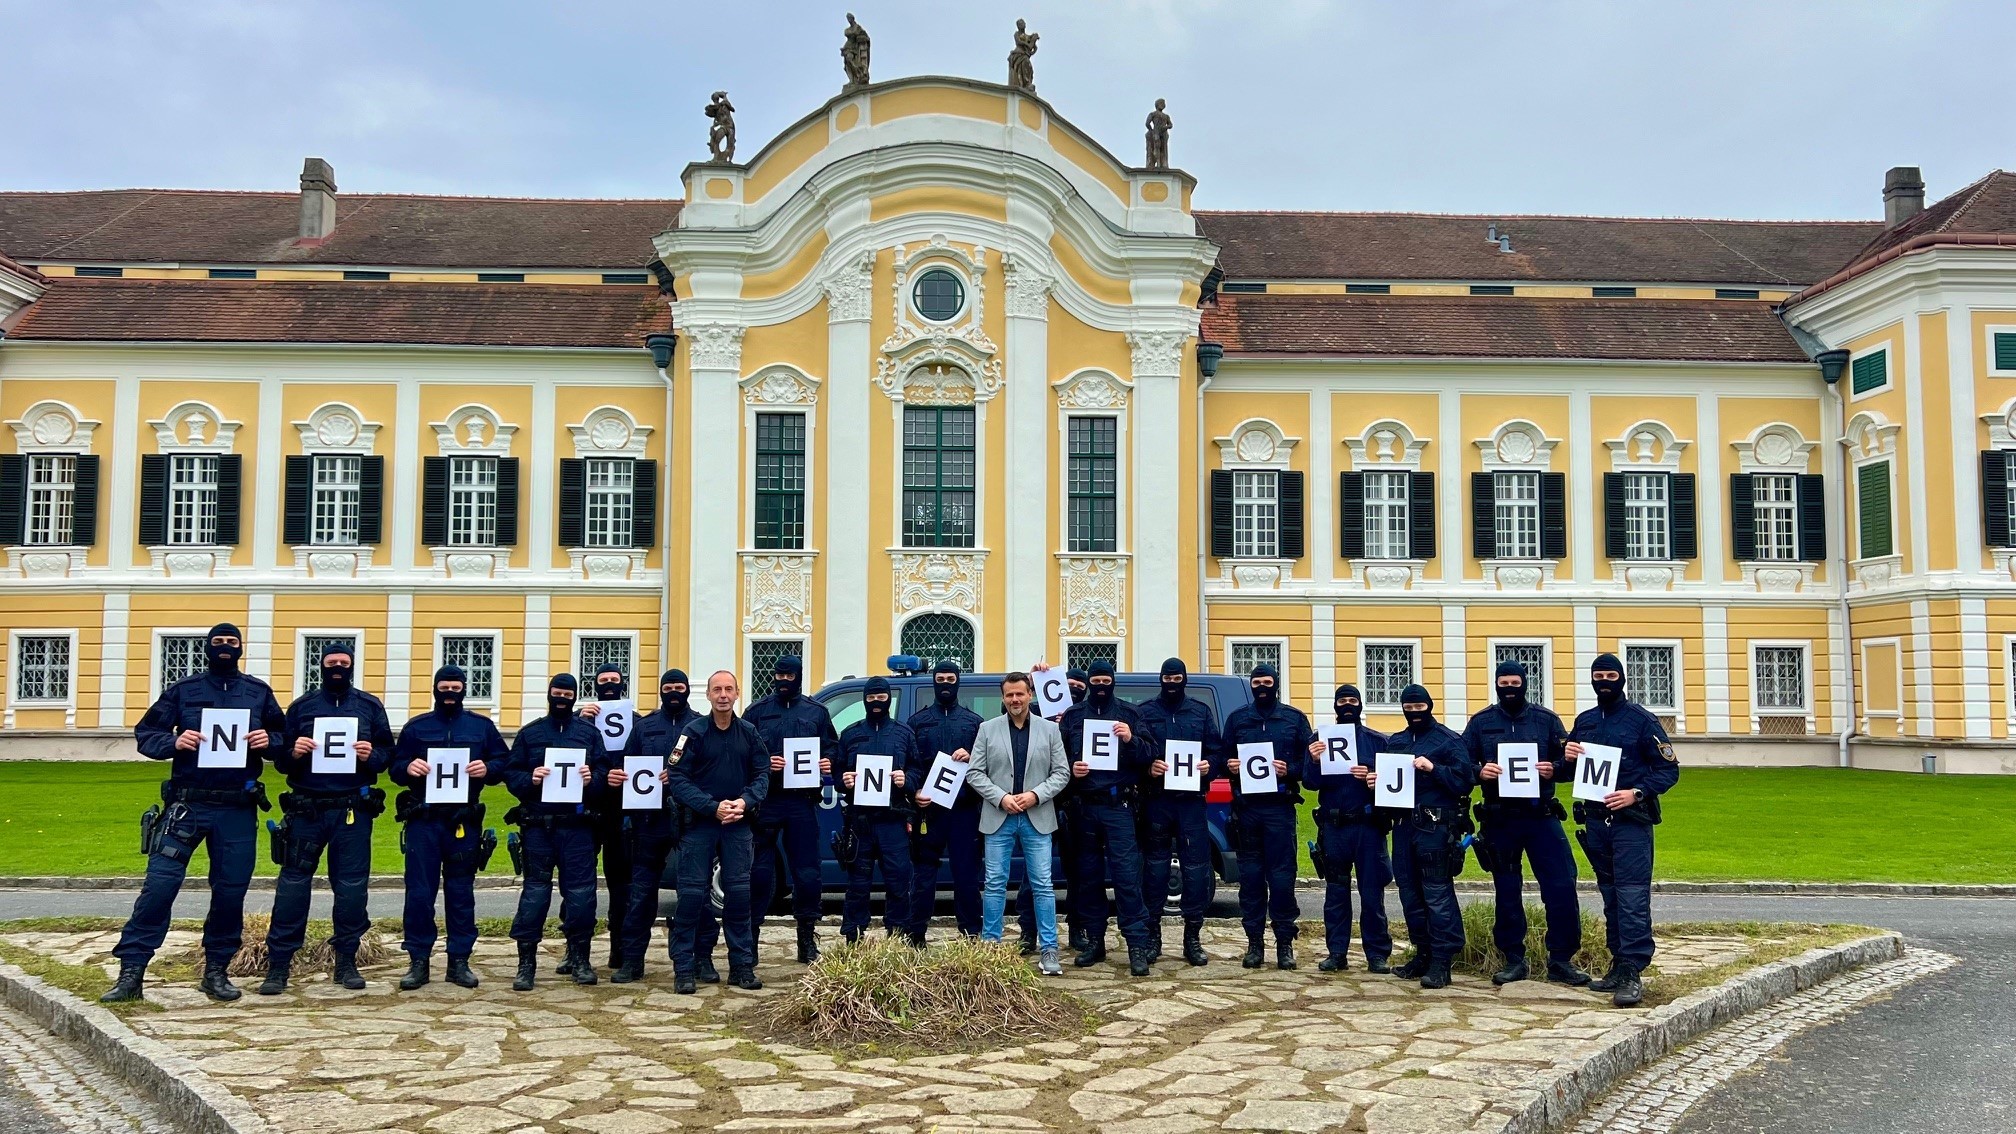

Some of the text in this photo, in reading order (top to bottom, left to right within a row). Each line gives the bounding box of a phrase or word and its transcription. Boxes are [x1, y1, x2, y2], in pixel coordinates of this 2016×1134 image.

[1042, 679, 1064, 703] C
[211, 724, 238, 752] N
[604, 712, 625, 738] S
[323, 731, 347, 759] E
[1091, 732, 1110, 757] E
[1327, 737, 1352, 762] R
[436, 762, 459, 789] H
[554, 762, 576, 788] T
[793, 750, 812, 775] E
[1173, 753, 1193, 778] H
[1246, 755, 1270, 780] G
[1508, 757, 1531, 783] E
[1582, 757, 1612, 787] M
[632, 769, 655, 795] C
[863, 767, 884, 793] N
[933, 766, 958, 795] E
[1386, 767, 1403, 794] J
